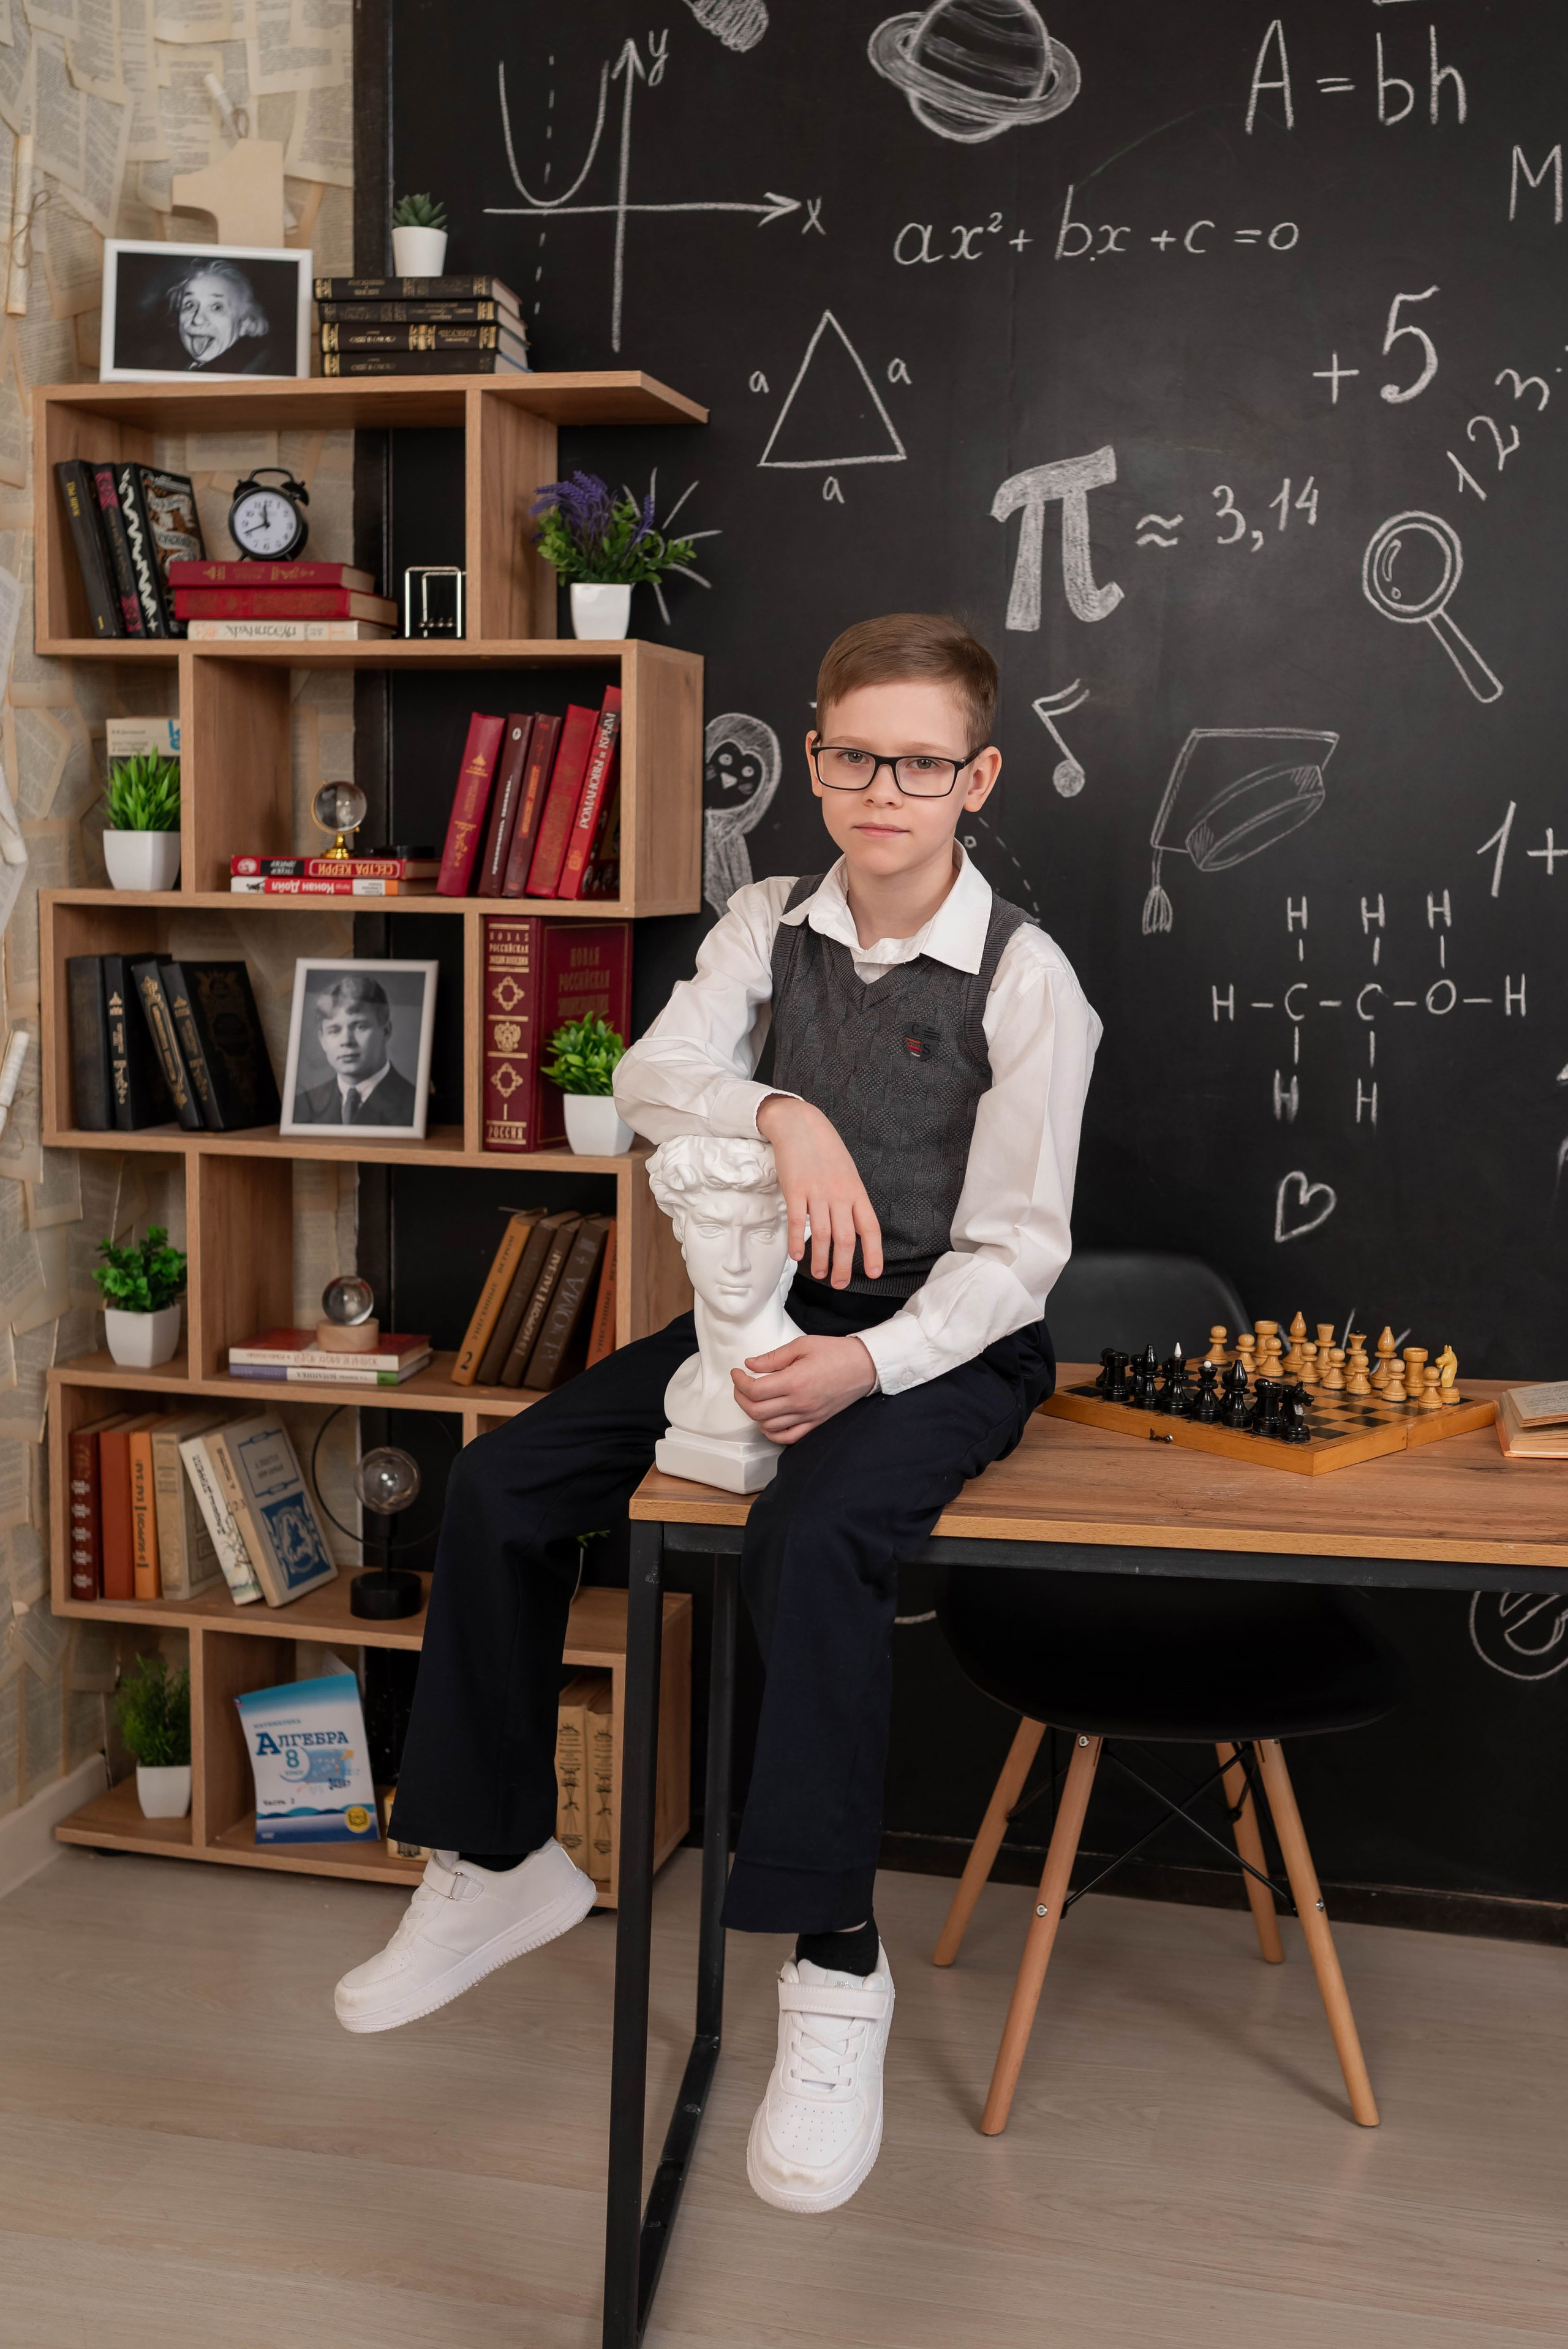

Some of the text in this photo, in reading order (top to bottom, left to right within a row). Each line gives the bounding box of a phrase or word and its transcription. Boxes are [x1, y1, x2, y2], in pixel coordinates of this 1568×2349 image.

[648, 28, 669, 86] y
[1246, 19, 1294, 135] A
[1376, 24, 1468, 126] bh
[1509, 144, 1563, 224] M
[801, 197, 826, 236] x
[750, 371, 770, 394] a
[887, 358, 913, 385] a
[823, 475, 845, 504] a
[1210, 475, 1320, 553] 3,14
[579, 760, 605, 829] РОМАНОВЫ
[598, 712, 616, 749] КРЫМ
[317, 862, 394, 876] СЕСТРА КЕРРИ
[271, 880, 301, 894] Дойл
[302, 881, 335, 894] Конан
[1287, 888, 1452, 934] H H H
[1212, 973, 1527, 1022] H C C O H
[1273, 1069, 1378, 1124] H H
[488, 1126, 524, 1140] РОССИЯ
[460, 1351, 473, 1371] 2
[285, 1749, 300, 1768] 8
